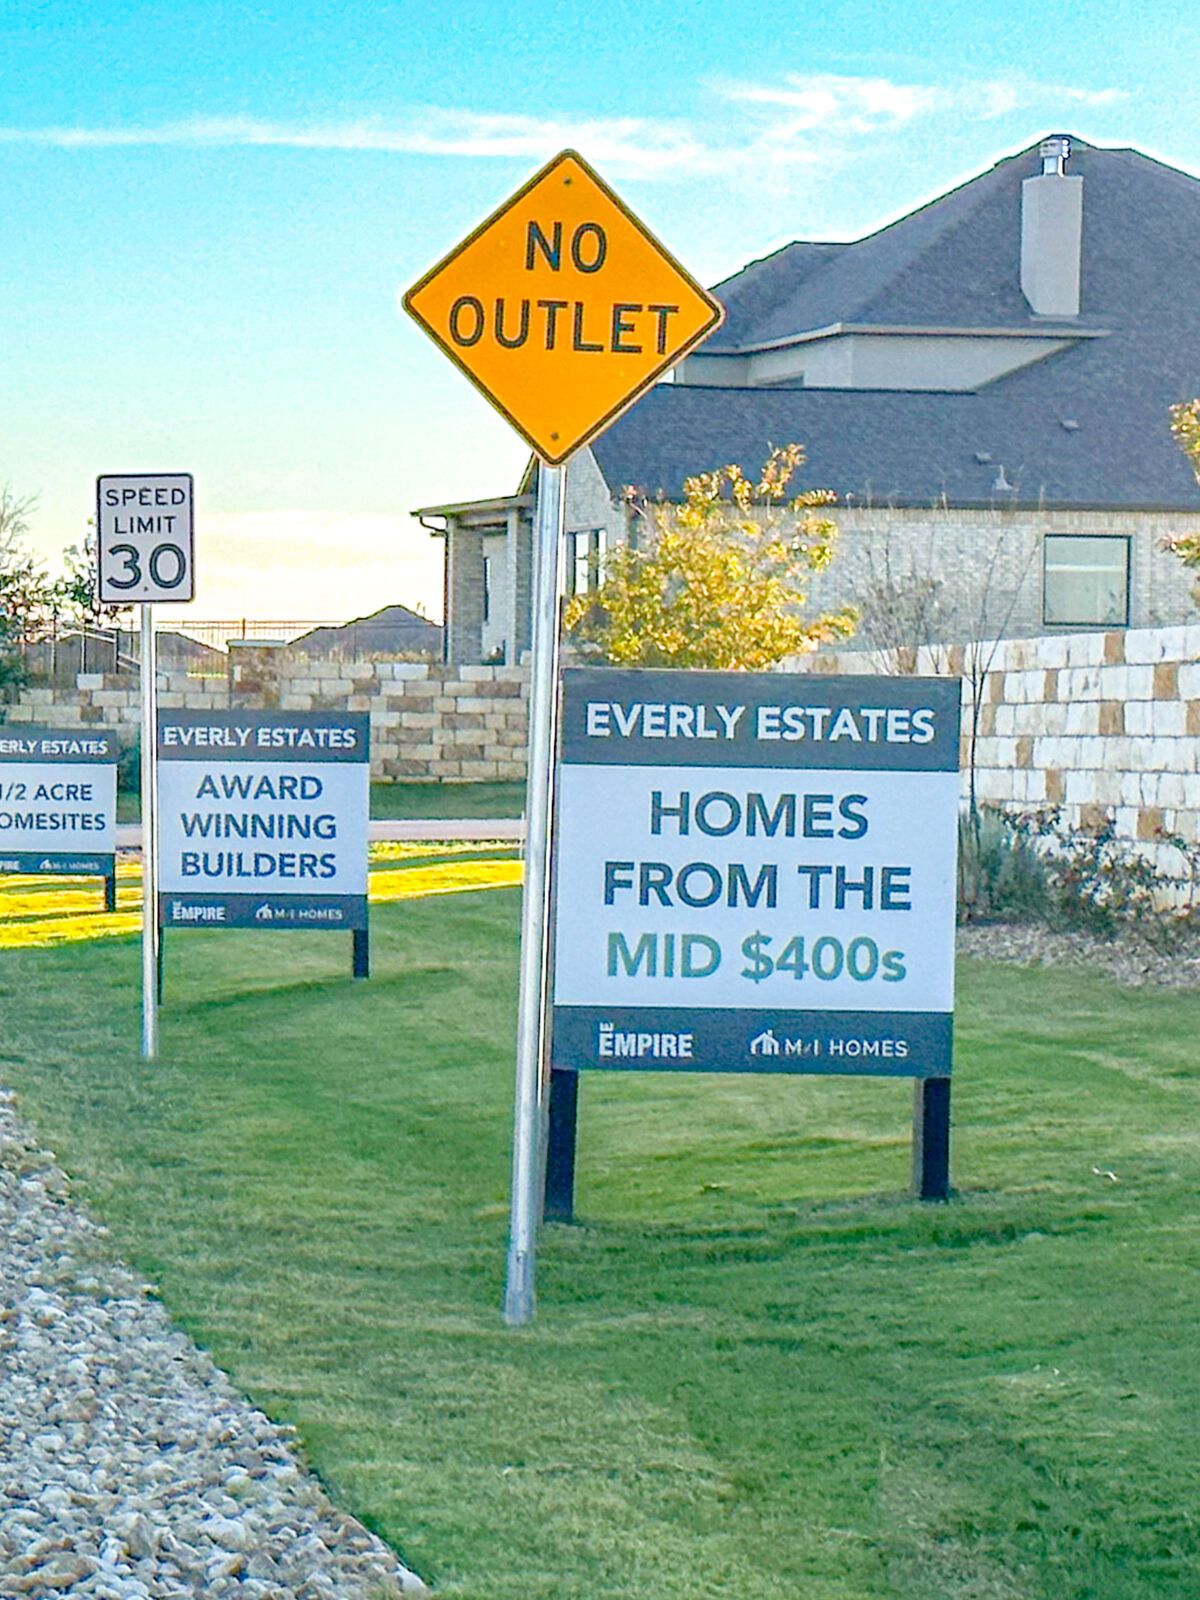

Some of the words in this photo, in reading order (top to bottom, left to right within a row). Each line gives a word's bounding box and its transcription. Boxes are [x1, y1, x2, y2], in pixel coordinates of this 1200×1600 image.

[525, 220, 608, 273] NO
[449, 295, 680, 355] OUTLET
[105, 487, 186, 507] SPEED
[114, 516, 177, 534] LIMIT
[106, 543, 187, 589] 30
[586, 703, 746, 739] EVERLY
[757, 705, 935, 743] ESTATES
[41, 740, 108, 755] ESTATES
[164, 727, 251, 746] EVERLY
[257, 728, 356, 748] ESTATES
[34, 784, 93, 801] ACRE
[196, 774, 323, 800] AWARD
[181, 813, 337, 839] WINNING
[650, 790, 869, 839] HOMES
[181, 852, 337, 878] BUILDERS
[603, 861, 778, 909] FROM
[798, 865, 912, 911] THE
[172, 906, 226, 921] EMPIRE
[299, 909, 344, 920] HOMES
[606, 932, 721, 979] MID
[741, 930, 907, 984] $400s
[599, 1032, 693, 1057] EMPIRE
[829, 1039, 909, 1057] HOMES
